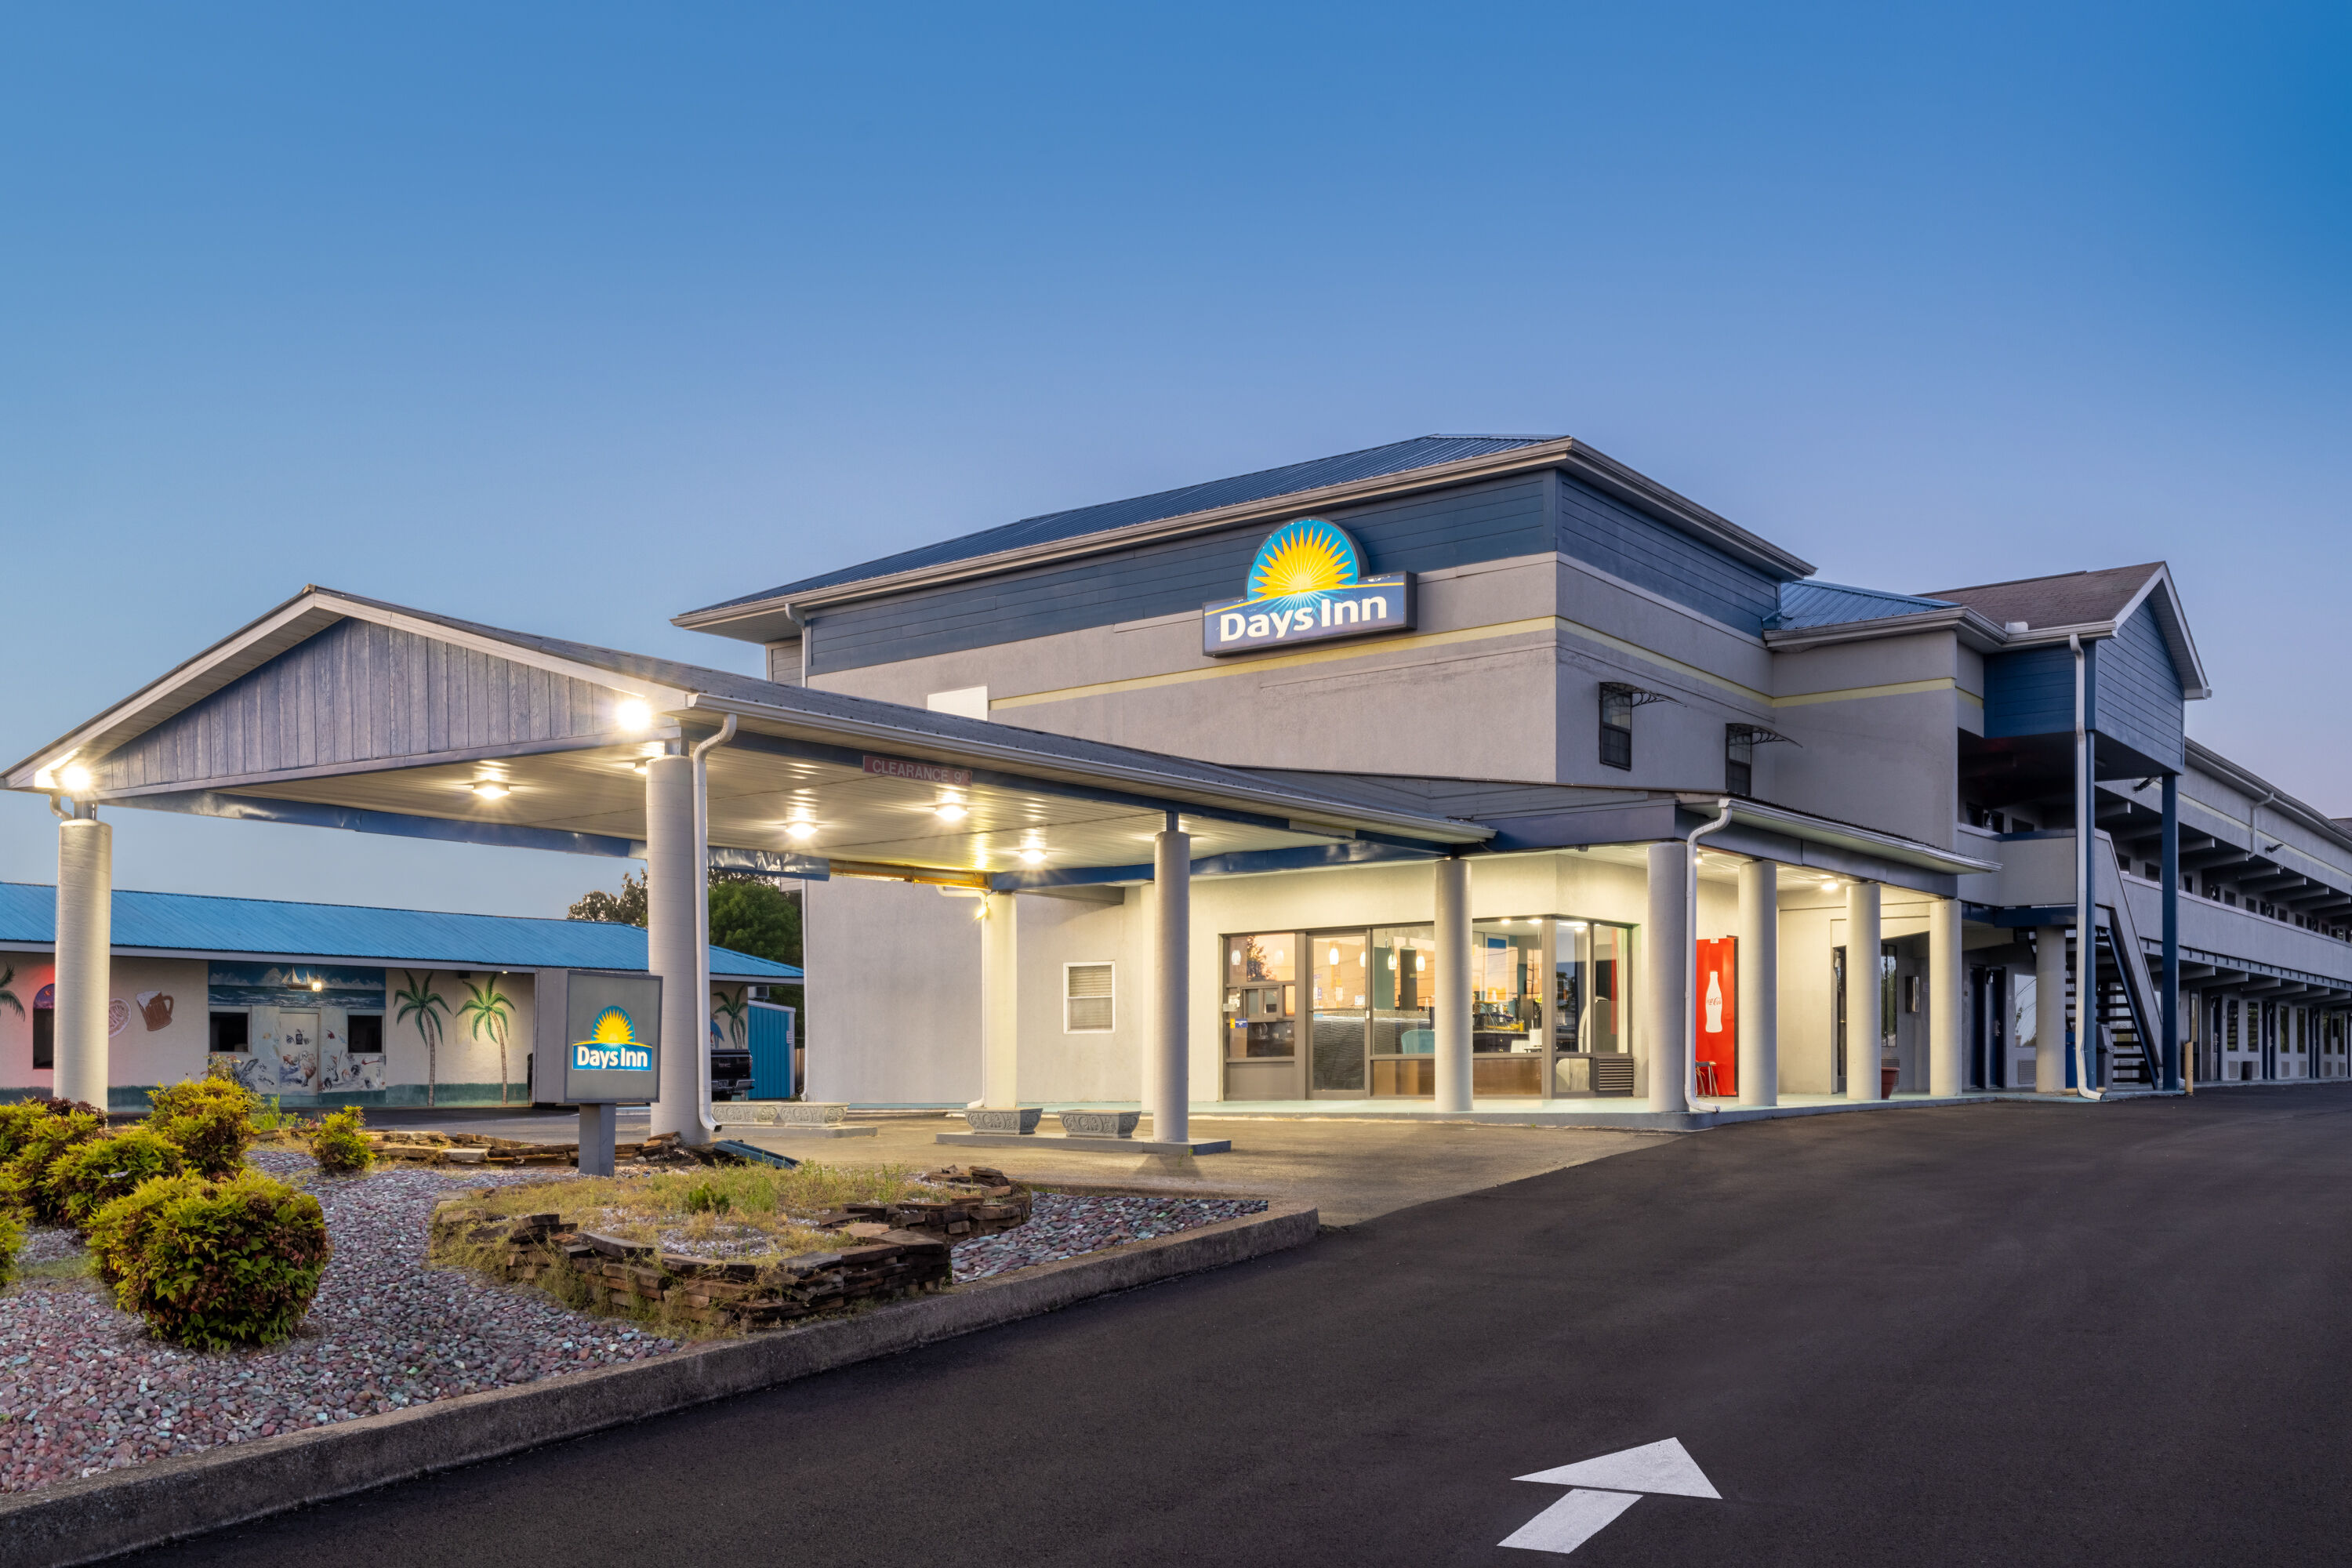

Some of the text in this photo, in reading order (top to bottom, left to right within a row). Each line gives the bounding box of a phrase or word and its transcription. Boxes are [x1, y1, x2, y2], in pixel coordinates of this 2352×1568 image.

[1220, 595, 1387, 643] Days Inn
[872, 759, 949, 782] CLEARANCE
[577, 1046, 648, 1069] Days Inn
